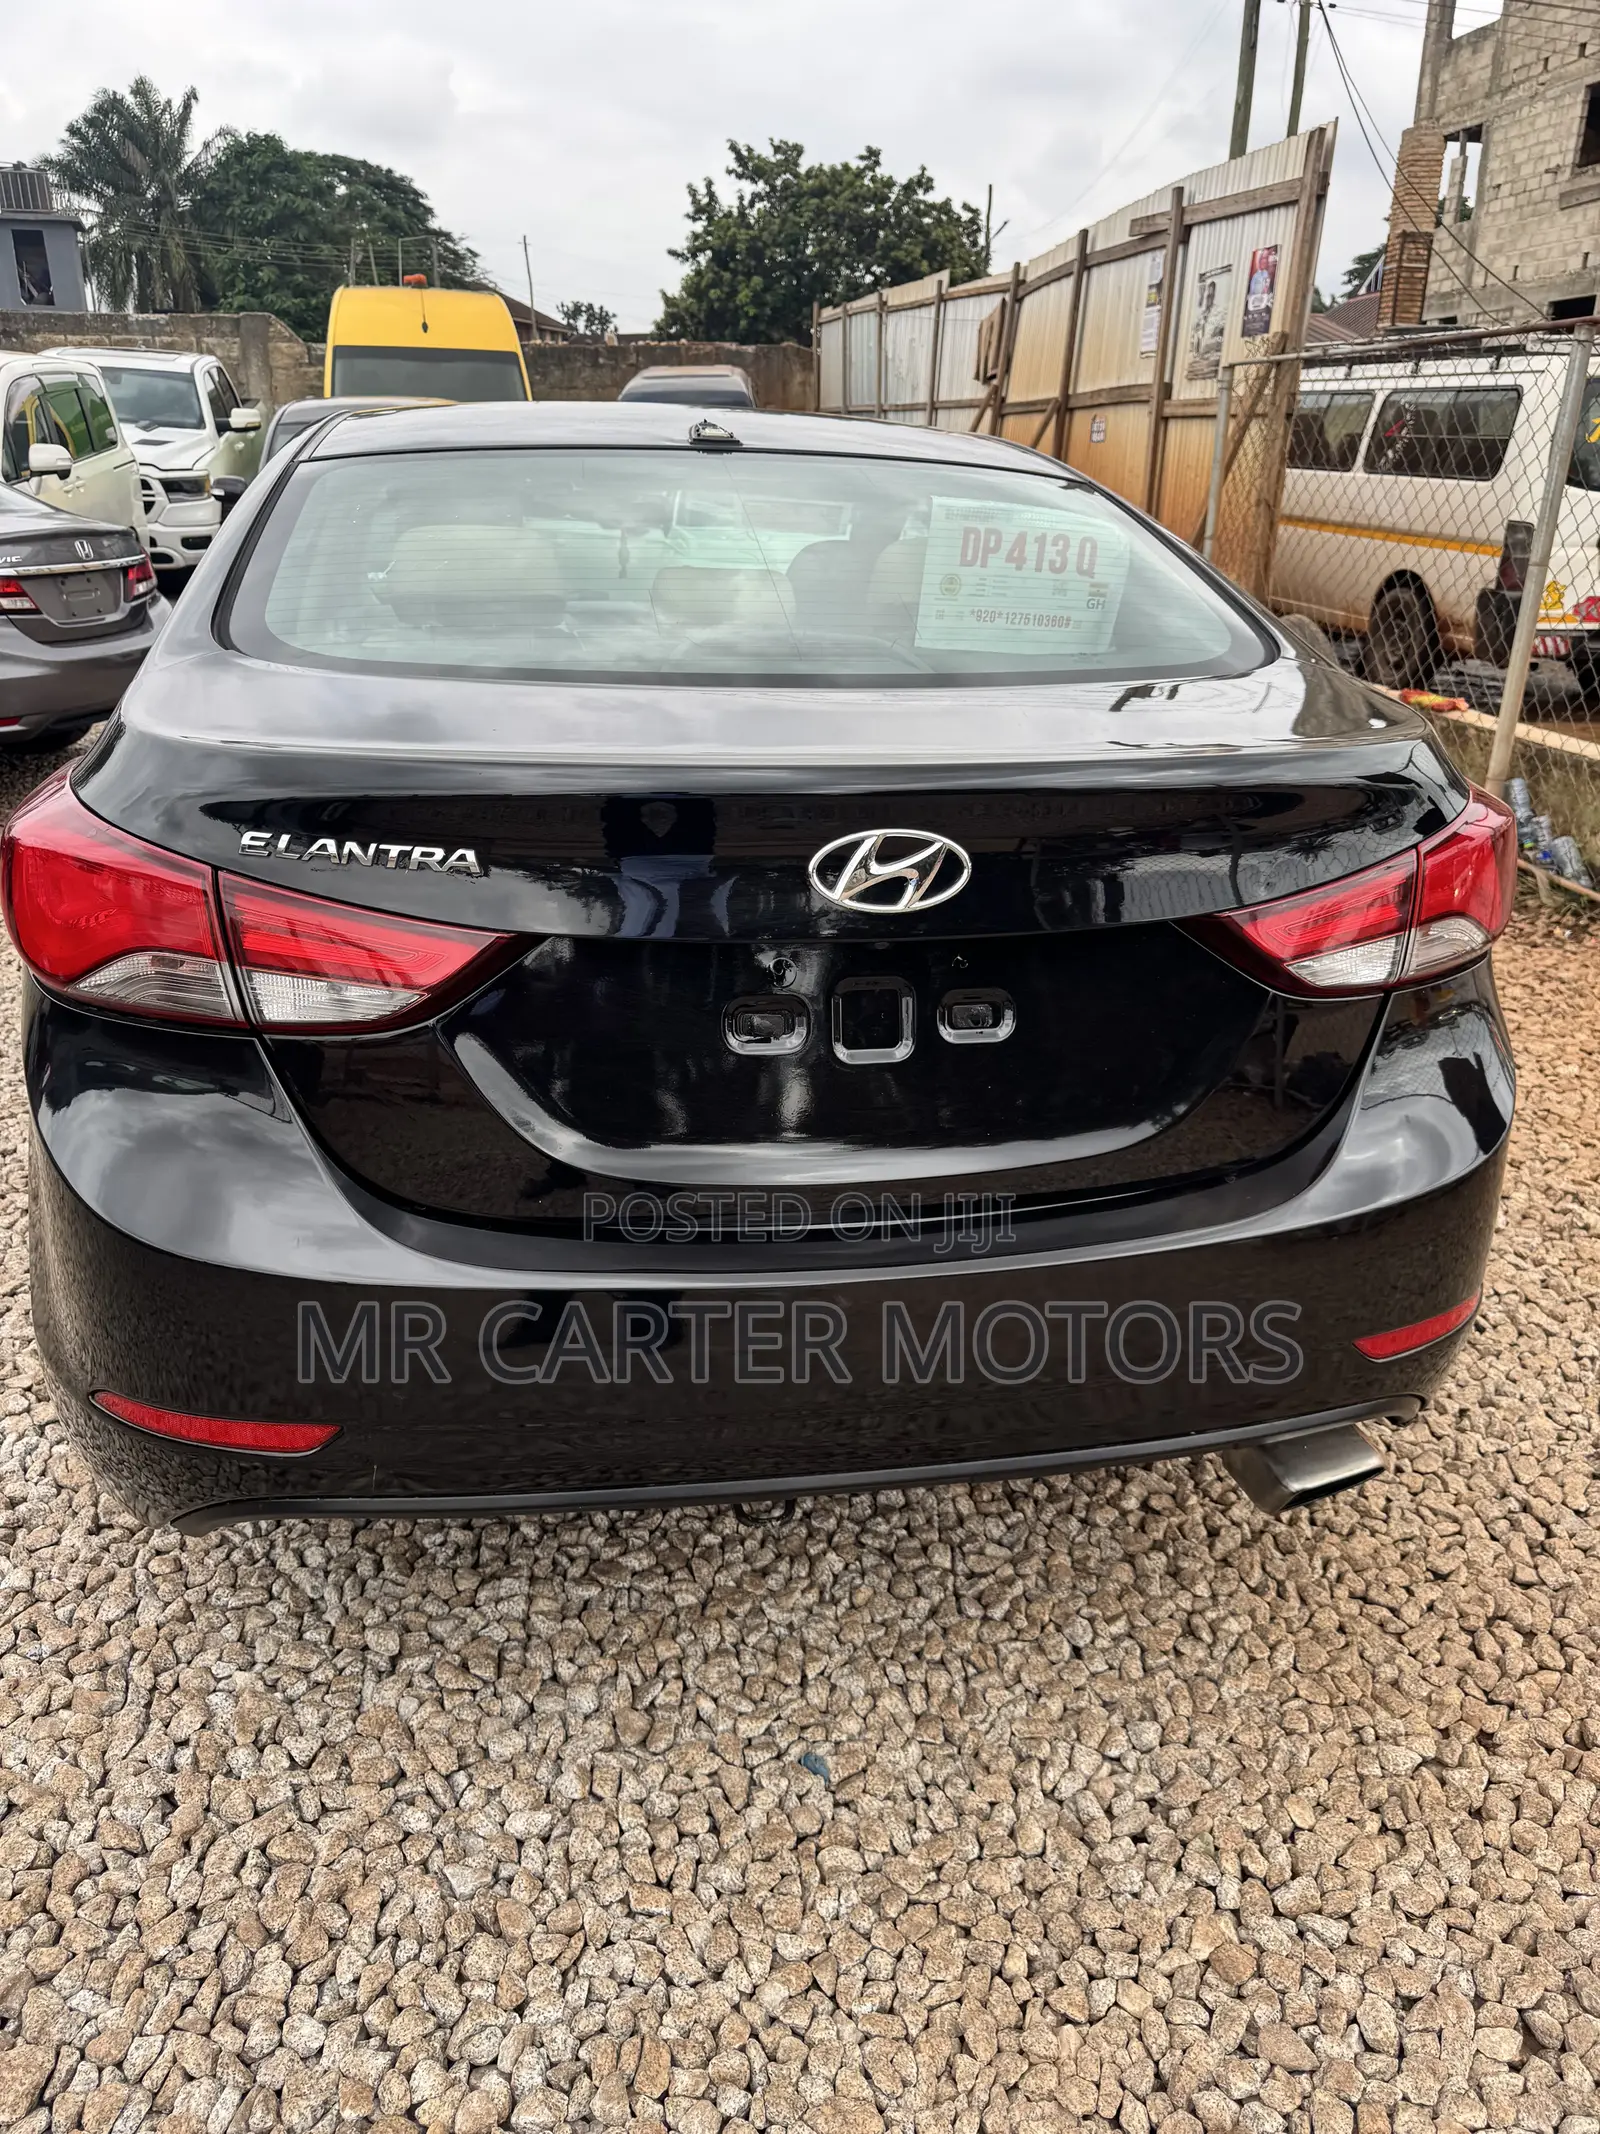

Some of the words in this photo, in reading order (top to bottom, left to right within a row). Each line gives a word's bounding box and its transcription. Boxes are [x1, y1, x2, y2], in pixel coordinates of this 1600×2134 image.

[959, 526, 1003, 569] DP
[1004, 530, 1071, 575] 413
[1075, 536, 1099, 579] Q
[1086, 598, 1106, 611] GH
[238, 831, 482, 875] ELANTRA
